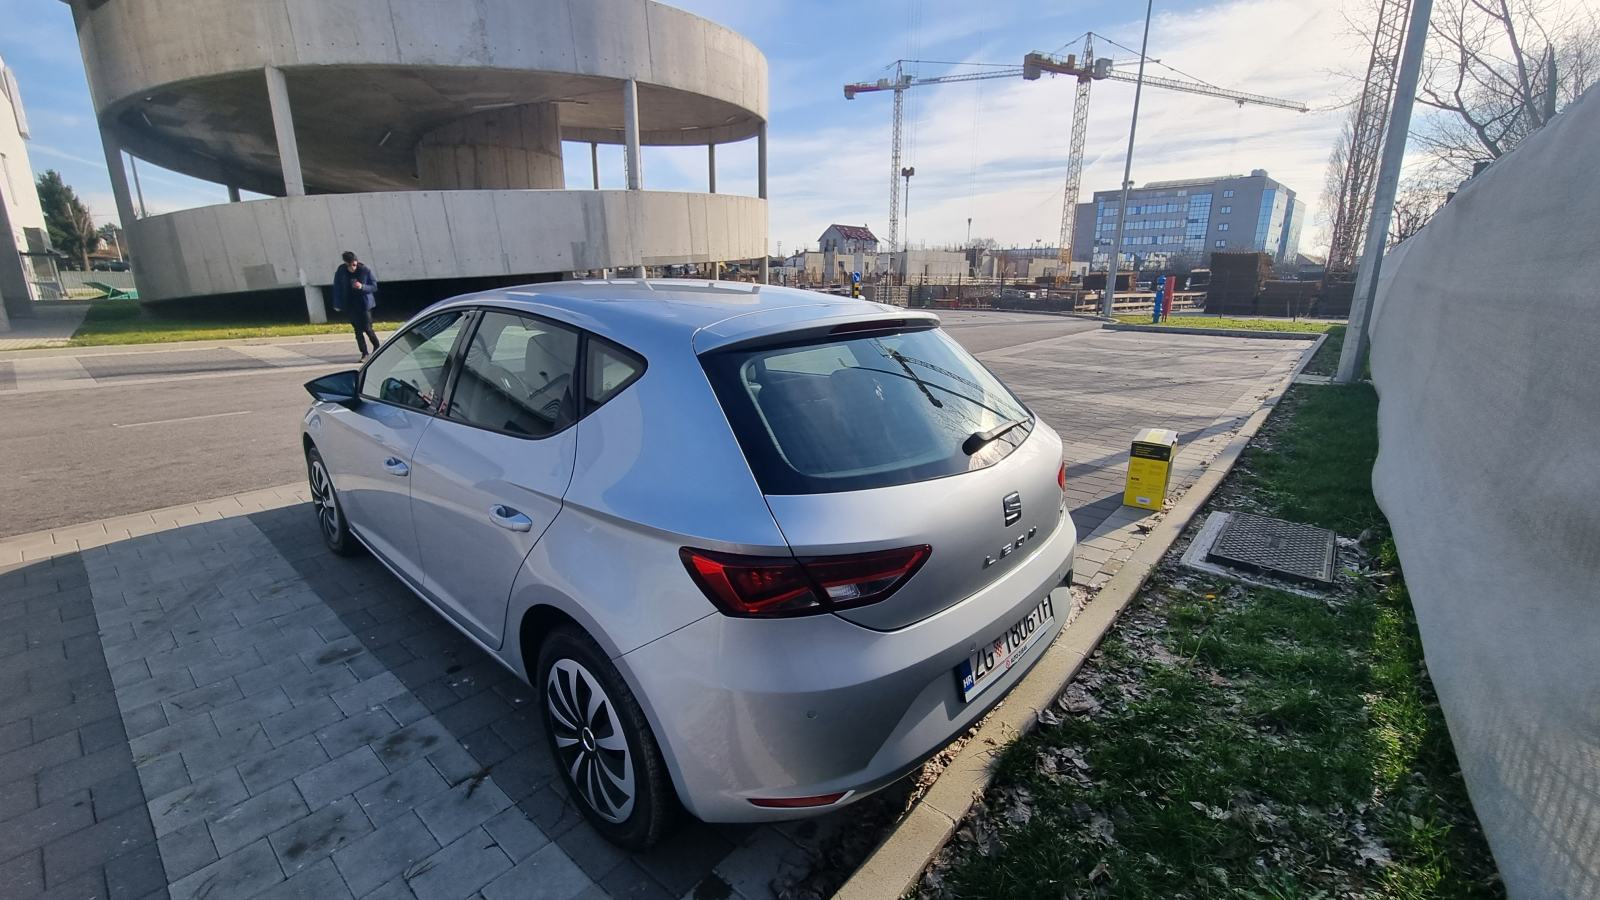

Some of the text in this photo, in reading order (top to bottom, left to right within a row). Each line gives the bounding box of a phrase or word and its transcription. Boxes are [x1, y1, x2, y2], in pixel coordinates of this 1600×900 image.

[982, 526, 1037, 569] LEON
[975, 646, 995, 679] ZG
[963, 674, 973, 688] HR
